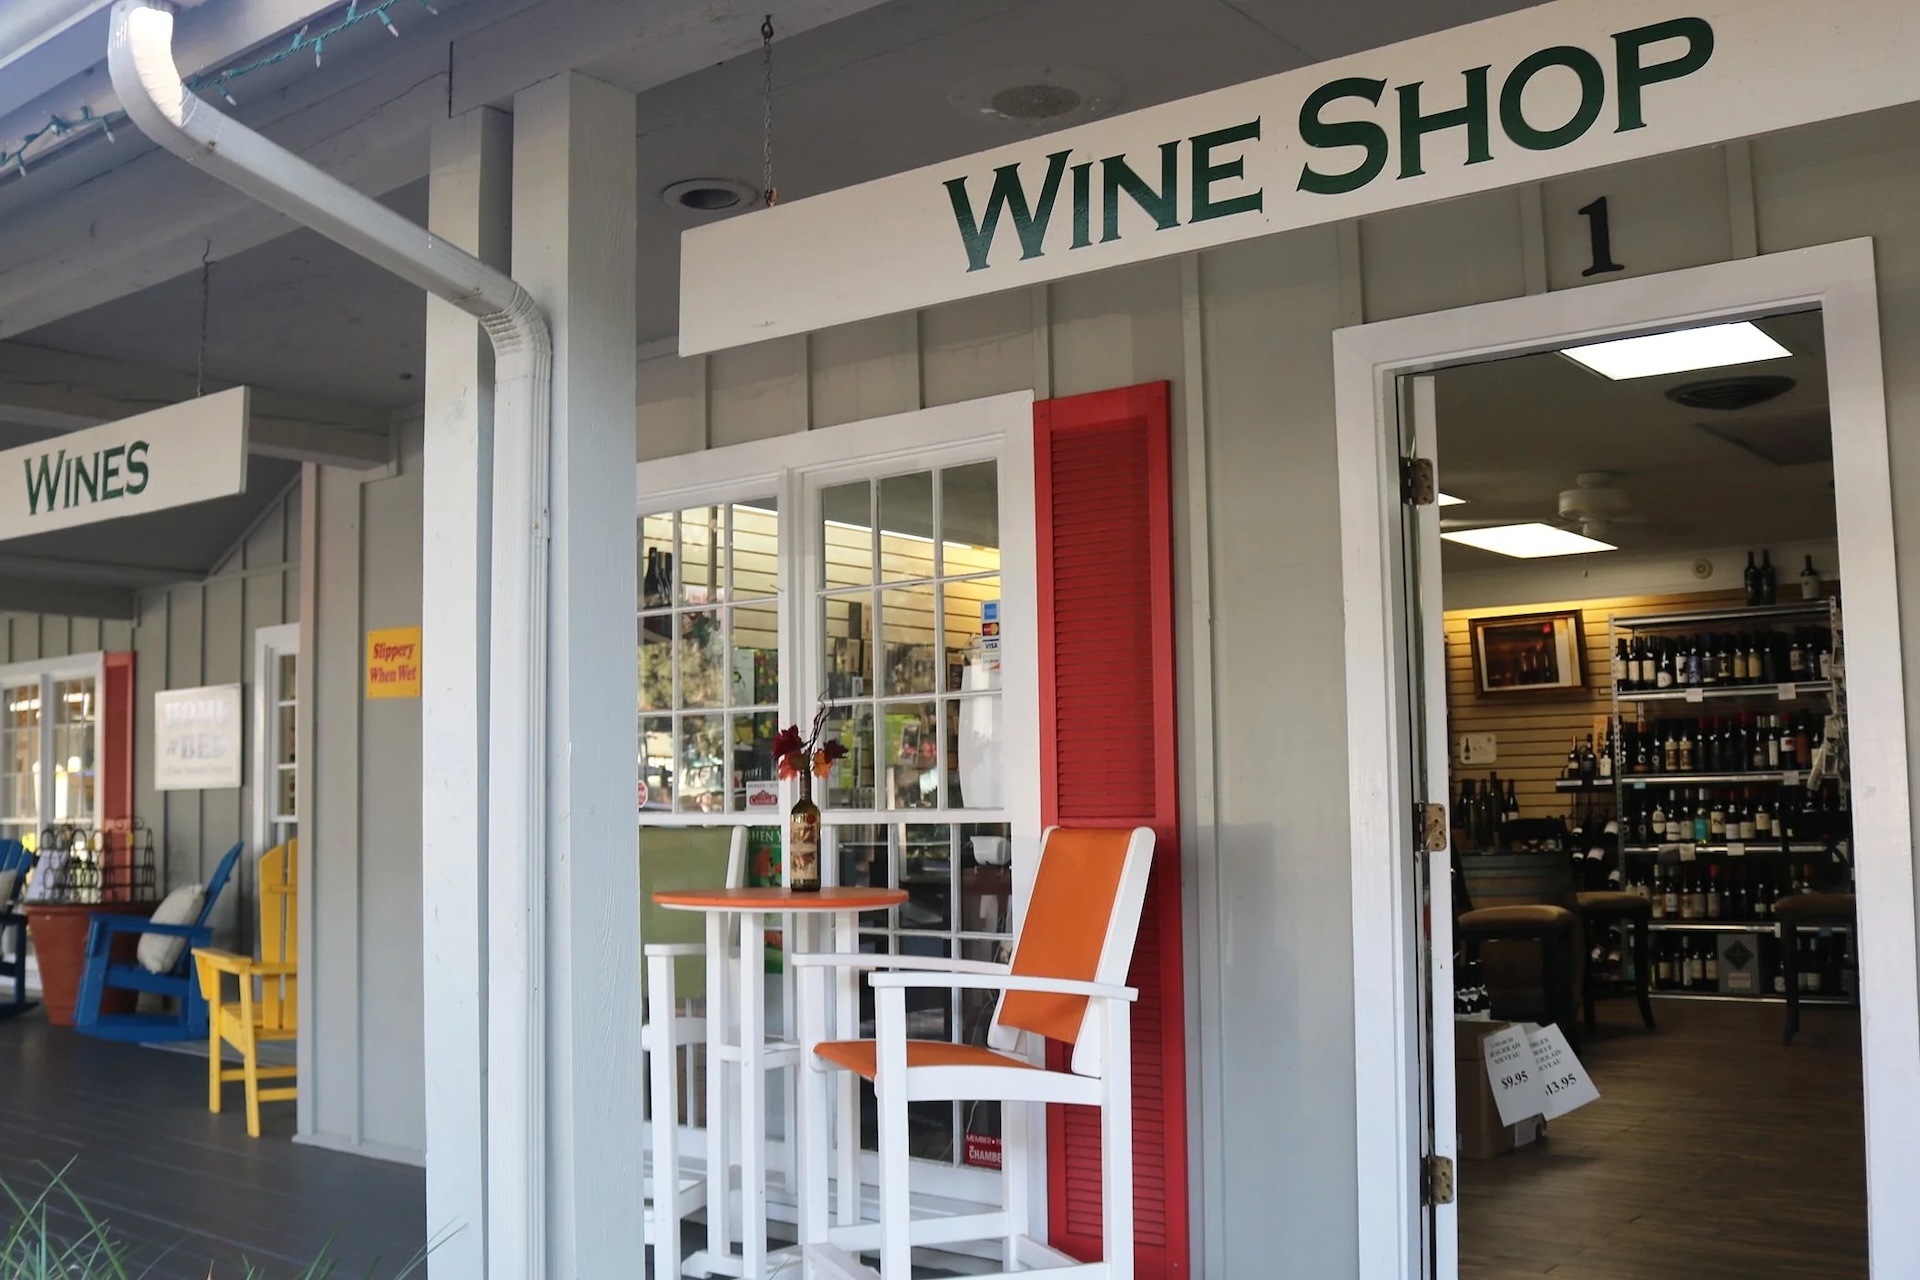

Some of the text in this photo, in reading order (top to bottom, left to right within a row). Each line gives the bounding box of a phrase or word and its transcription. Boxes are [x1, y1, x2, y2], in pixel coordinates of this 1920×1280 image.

[943, 17, 1714, 273] WINE SHOP
[1578, 196, 1625, 277] 1
[24, 440, 150, 516] WINES
[373, 640, 416, 662] Slippery
[985, 642, 998, 650] VISA
[370, 664, 416, 683] When Wet
[1501, 1070, 1529, 1090] $9.95
